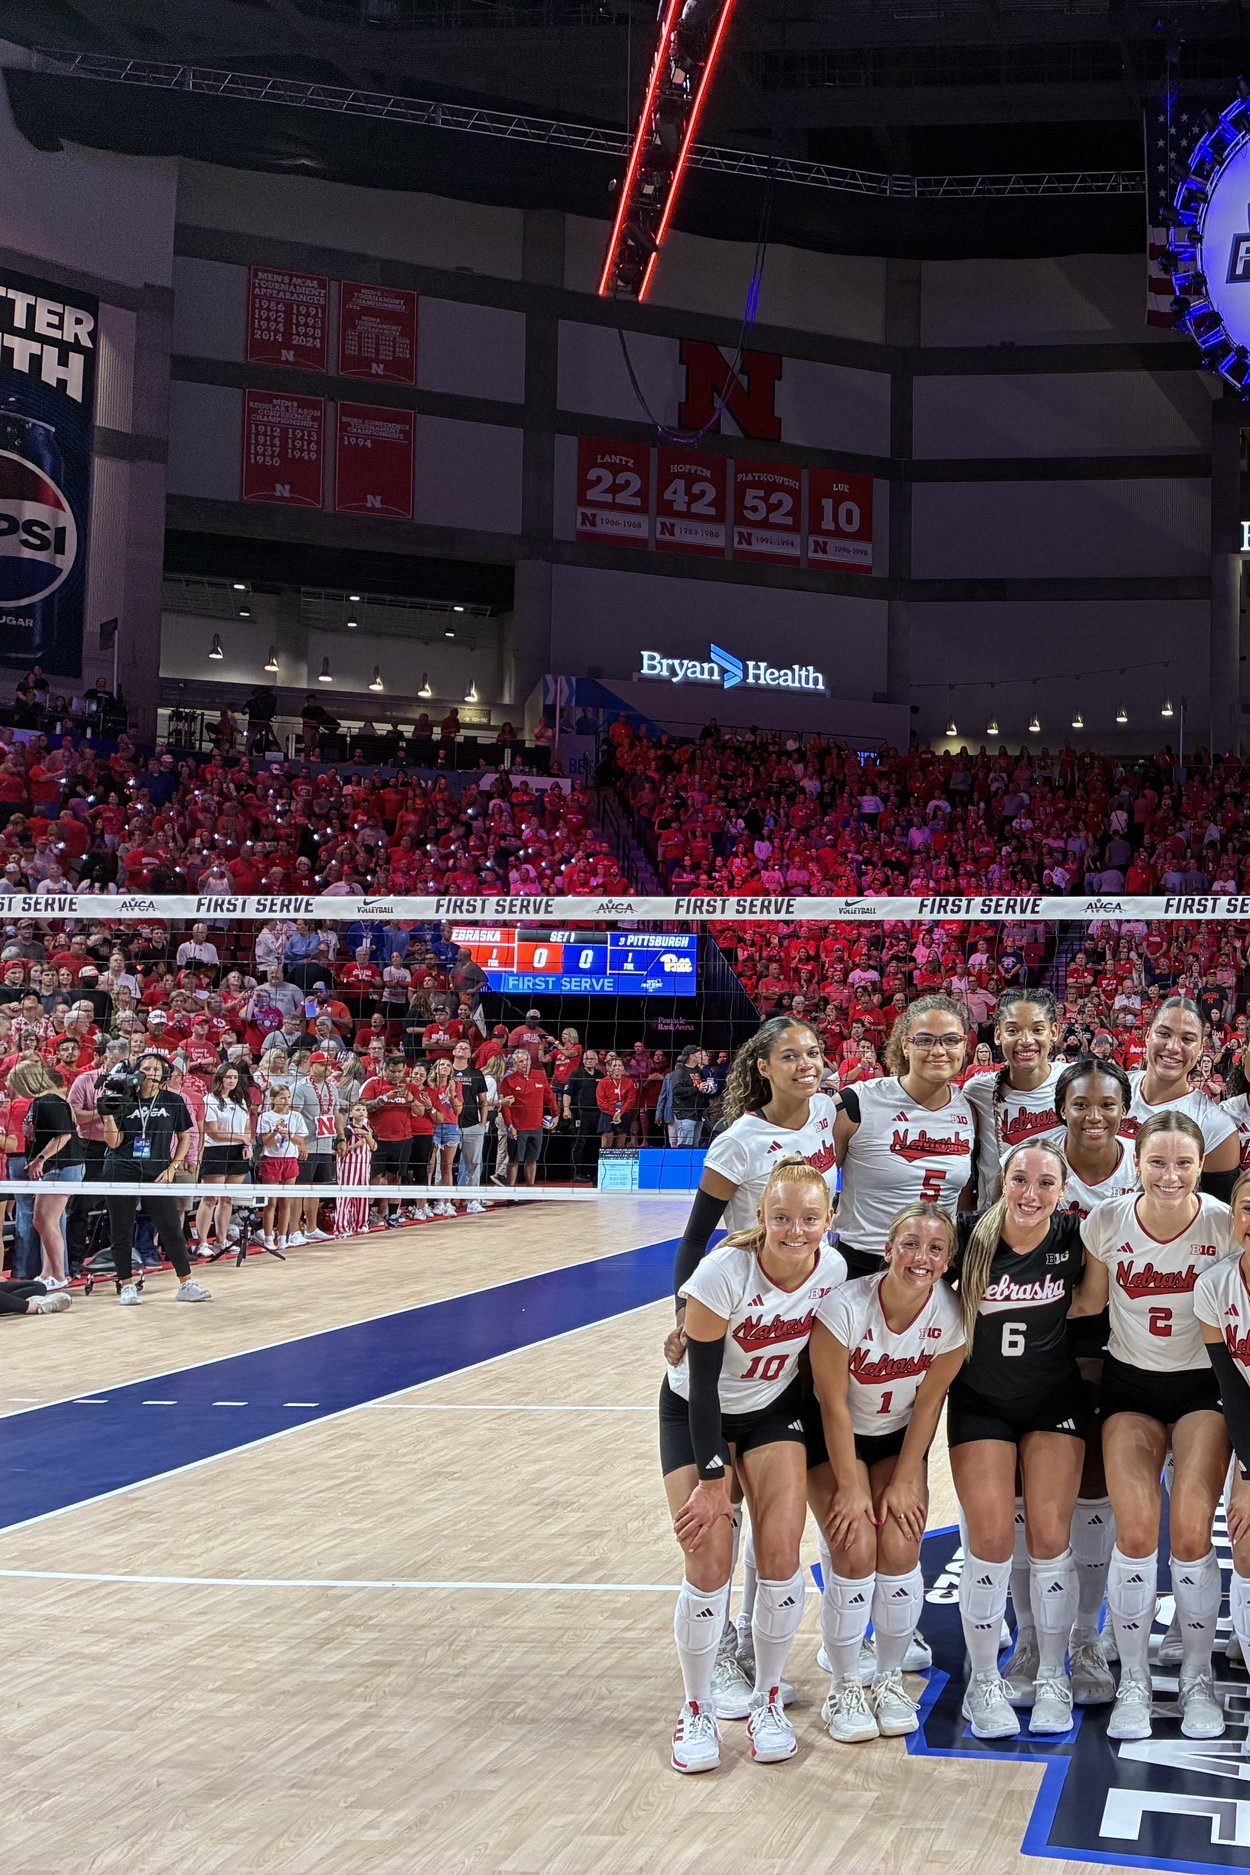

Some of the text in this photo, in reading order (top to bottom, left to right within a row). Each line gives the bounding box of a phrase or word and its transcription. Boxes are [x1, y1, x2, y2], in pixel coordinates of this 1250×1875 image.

[255, 280, 325, 297] TOURNAMENT
[255, 299, 322, 317] 1986 1991
[292, 314, 321, 327] 1993
[254, 330, 321, 348] 2014 2024
[292, 325, 321, 337] 1998
[281, 349, 294, 361] N
[371, 362, 384, 375] N
[678, 338, 783, 443] N
[251, 424, 317, 440] 1912 1913
[251, 434, 317, 451] 1914 1916
[344, 436, 372, 448] 1994
[250, 454, 280, 466] 1950
[251, 444, 317, 460] 1937 1949
[597, 454, 634, 468] LANTZ
[670, 464, 712, 478] HOPPEN
[586, 467, 642, 506] 22
[737, 472, 800, 490] PIATKOWSKI
[832, 483, 850, 493] LUE
[274, 483, 291, 497] N
[663, 479, 717, 515] 42
[366, 494, 382, 508] N
[743, 488, 793, 525] 52
[580, 512, 597, 528] N
[821, 498, 860, 533] 10
[660, 521, 676, 537] N
[737, 531, 752, 546] N
[812, 540, 828, 555] N
[640, 650, 826, 690] Bryan Health
[21, 896, 79, 912] SERVE
[117, 897, 158, 912] AVCA
[195, 896, 247, 913] FIRST
[255, 897, 315, 913] SERVE
[356, 906, 394, 914] VOLLEYBALL
[434, 898, 490, 915] FIRST
[494, 898, 555, 915] SERVE
[592, 899, 638, 914] AVCA
[674, 898, 730, 915] FIRST
[735, 898, 797, 915] SERVE
[838, 907, 877, 915] VOLLEYBALL
[918, 898, 975, 914] FIRST
[980, 898, 1043, 915] SERVE
[1080, 899, 1125, 914] AVCA
[1164, 898, 1221, 914] FIRST
[451, 929, 501, 942] EBRASKA
[627, 935, 689, 947] PITTSBURGH
[532, 948, 548, 968] 0
[578, 949, 594, 969] 0
[508, 976, 614, 991] FIRST SERVE
[316, 1116, 336, 1137] N
[891, 1129, 970, 1157] Nebraska
[919, 1168, 947, 1203] 5
[984, 1274, 1065, 1303] ebraska
[1148, 1307, 1173, 1337] 2
[1001, 1322, 1027, 1357] 6
[740, 1353, 789, 1381] 10
[876, 1391, 895, 1414] 1
